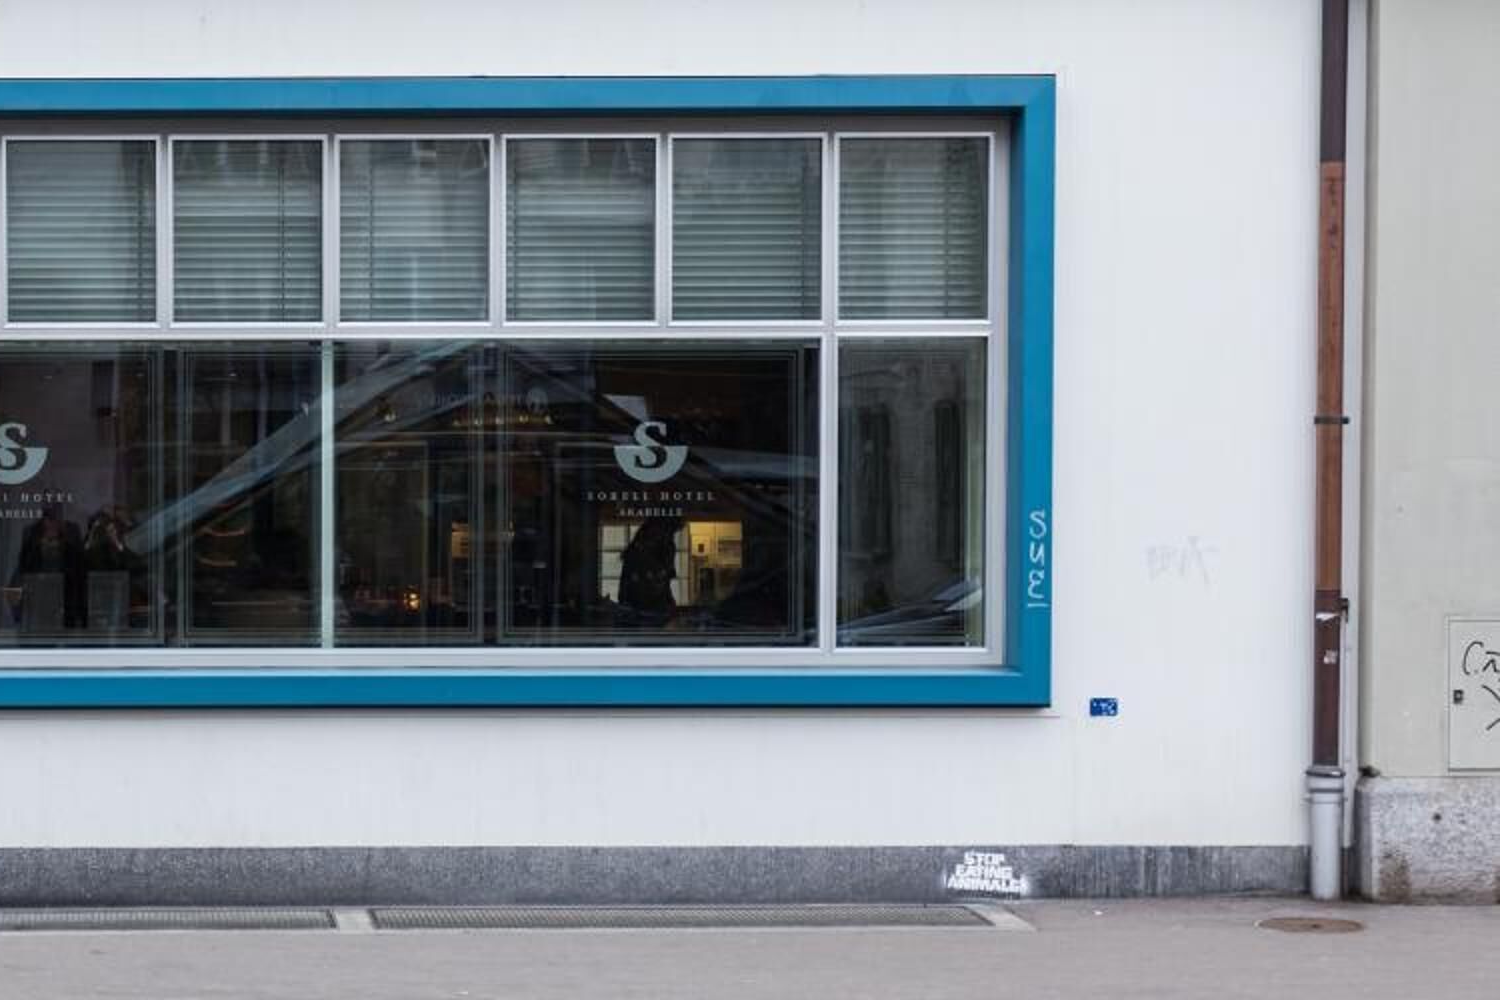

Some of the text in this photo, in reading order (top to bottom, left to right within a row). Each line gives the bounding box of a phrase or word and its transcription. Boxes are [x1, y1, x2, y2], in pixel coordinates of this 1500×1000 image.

[20, 492, 76, 503] HOTEL
[659, 490, 716, 501] HOTEL
[963, 850, 1005, 865] STOP
[955, 863, 1013, 879] EATING
